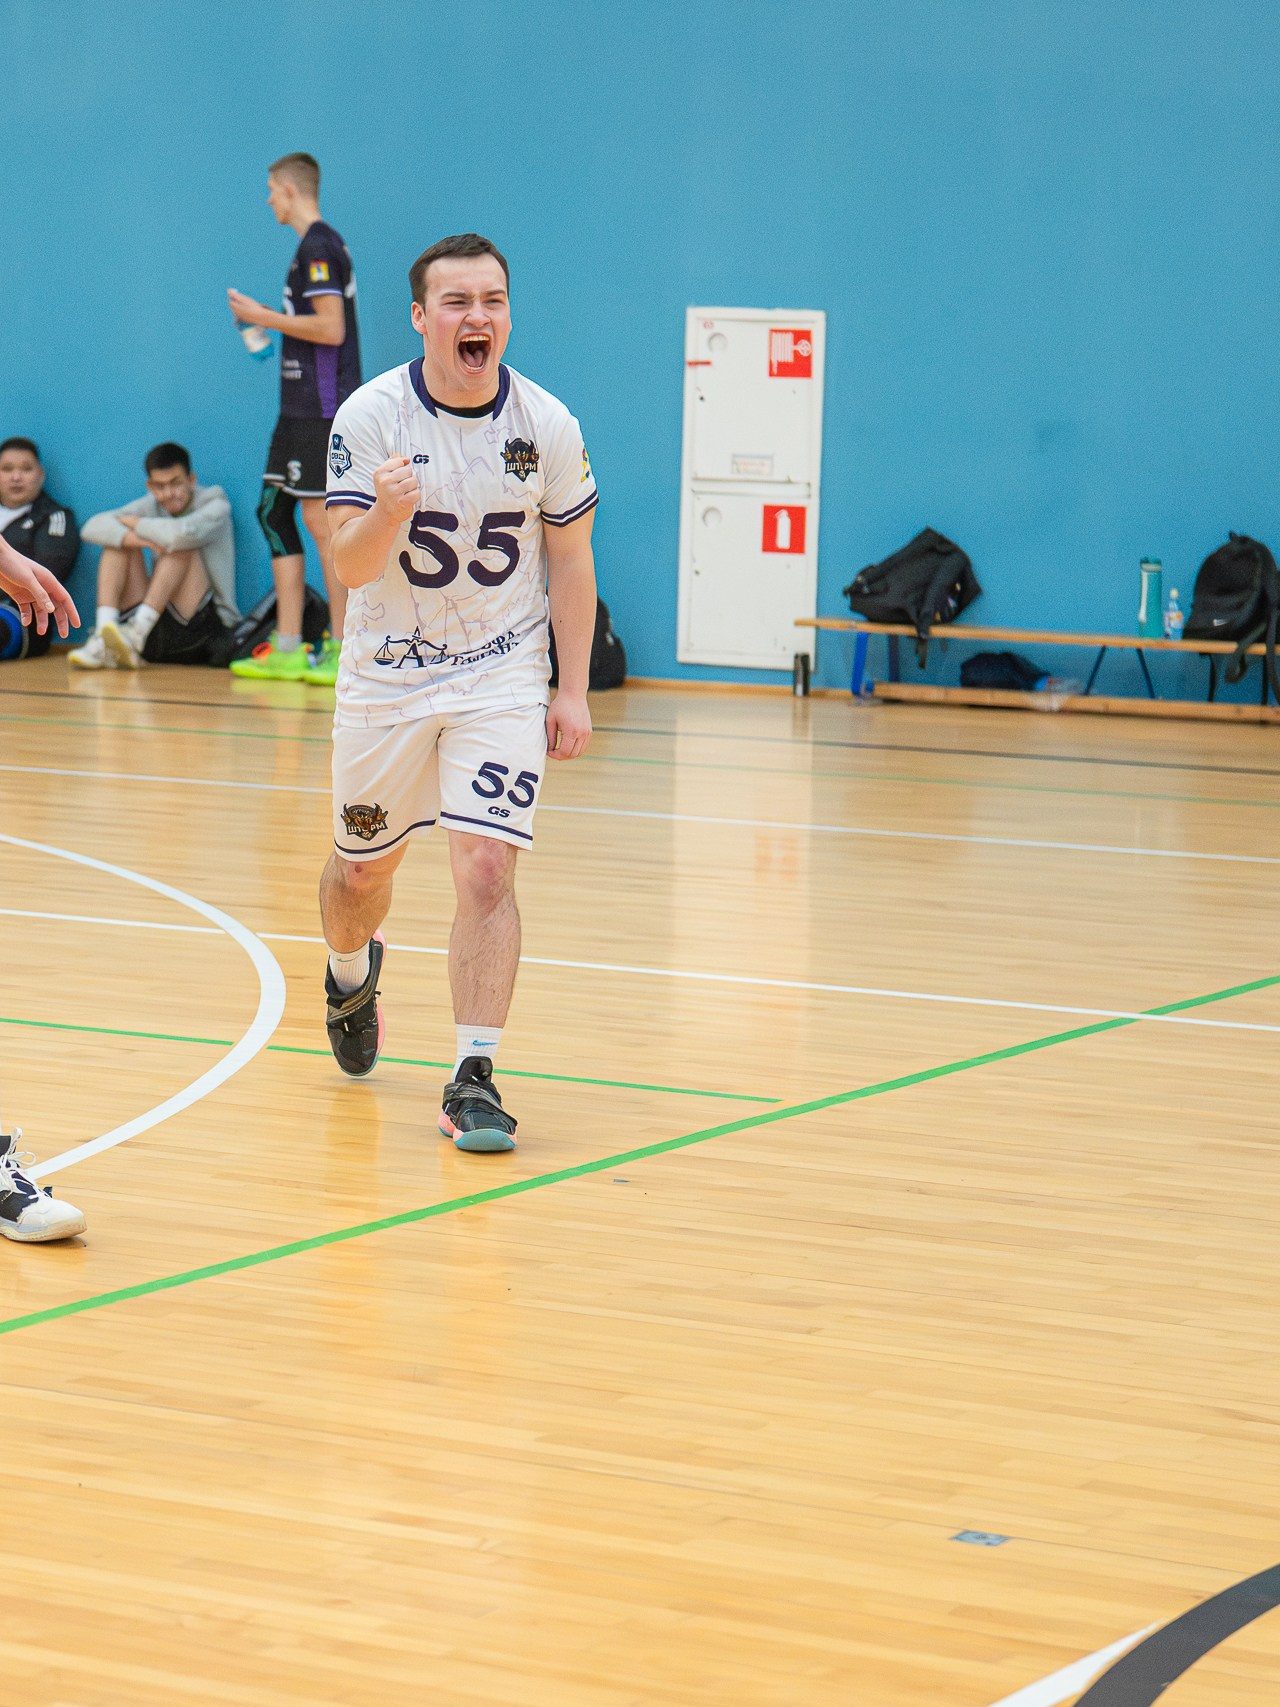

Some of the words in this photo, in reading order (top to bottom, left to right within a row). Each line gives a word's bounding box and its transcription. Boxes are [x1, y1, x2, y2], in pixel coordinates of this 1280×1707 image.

[413, 454, 429, 465] GS
[506, 462, 537, 472] ШТРМ
[399, 510, 525, 589] 55
[471, 761, 539, 809] 55
[487, 806, 511, 818] GS
